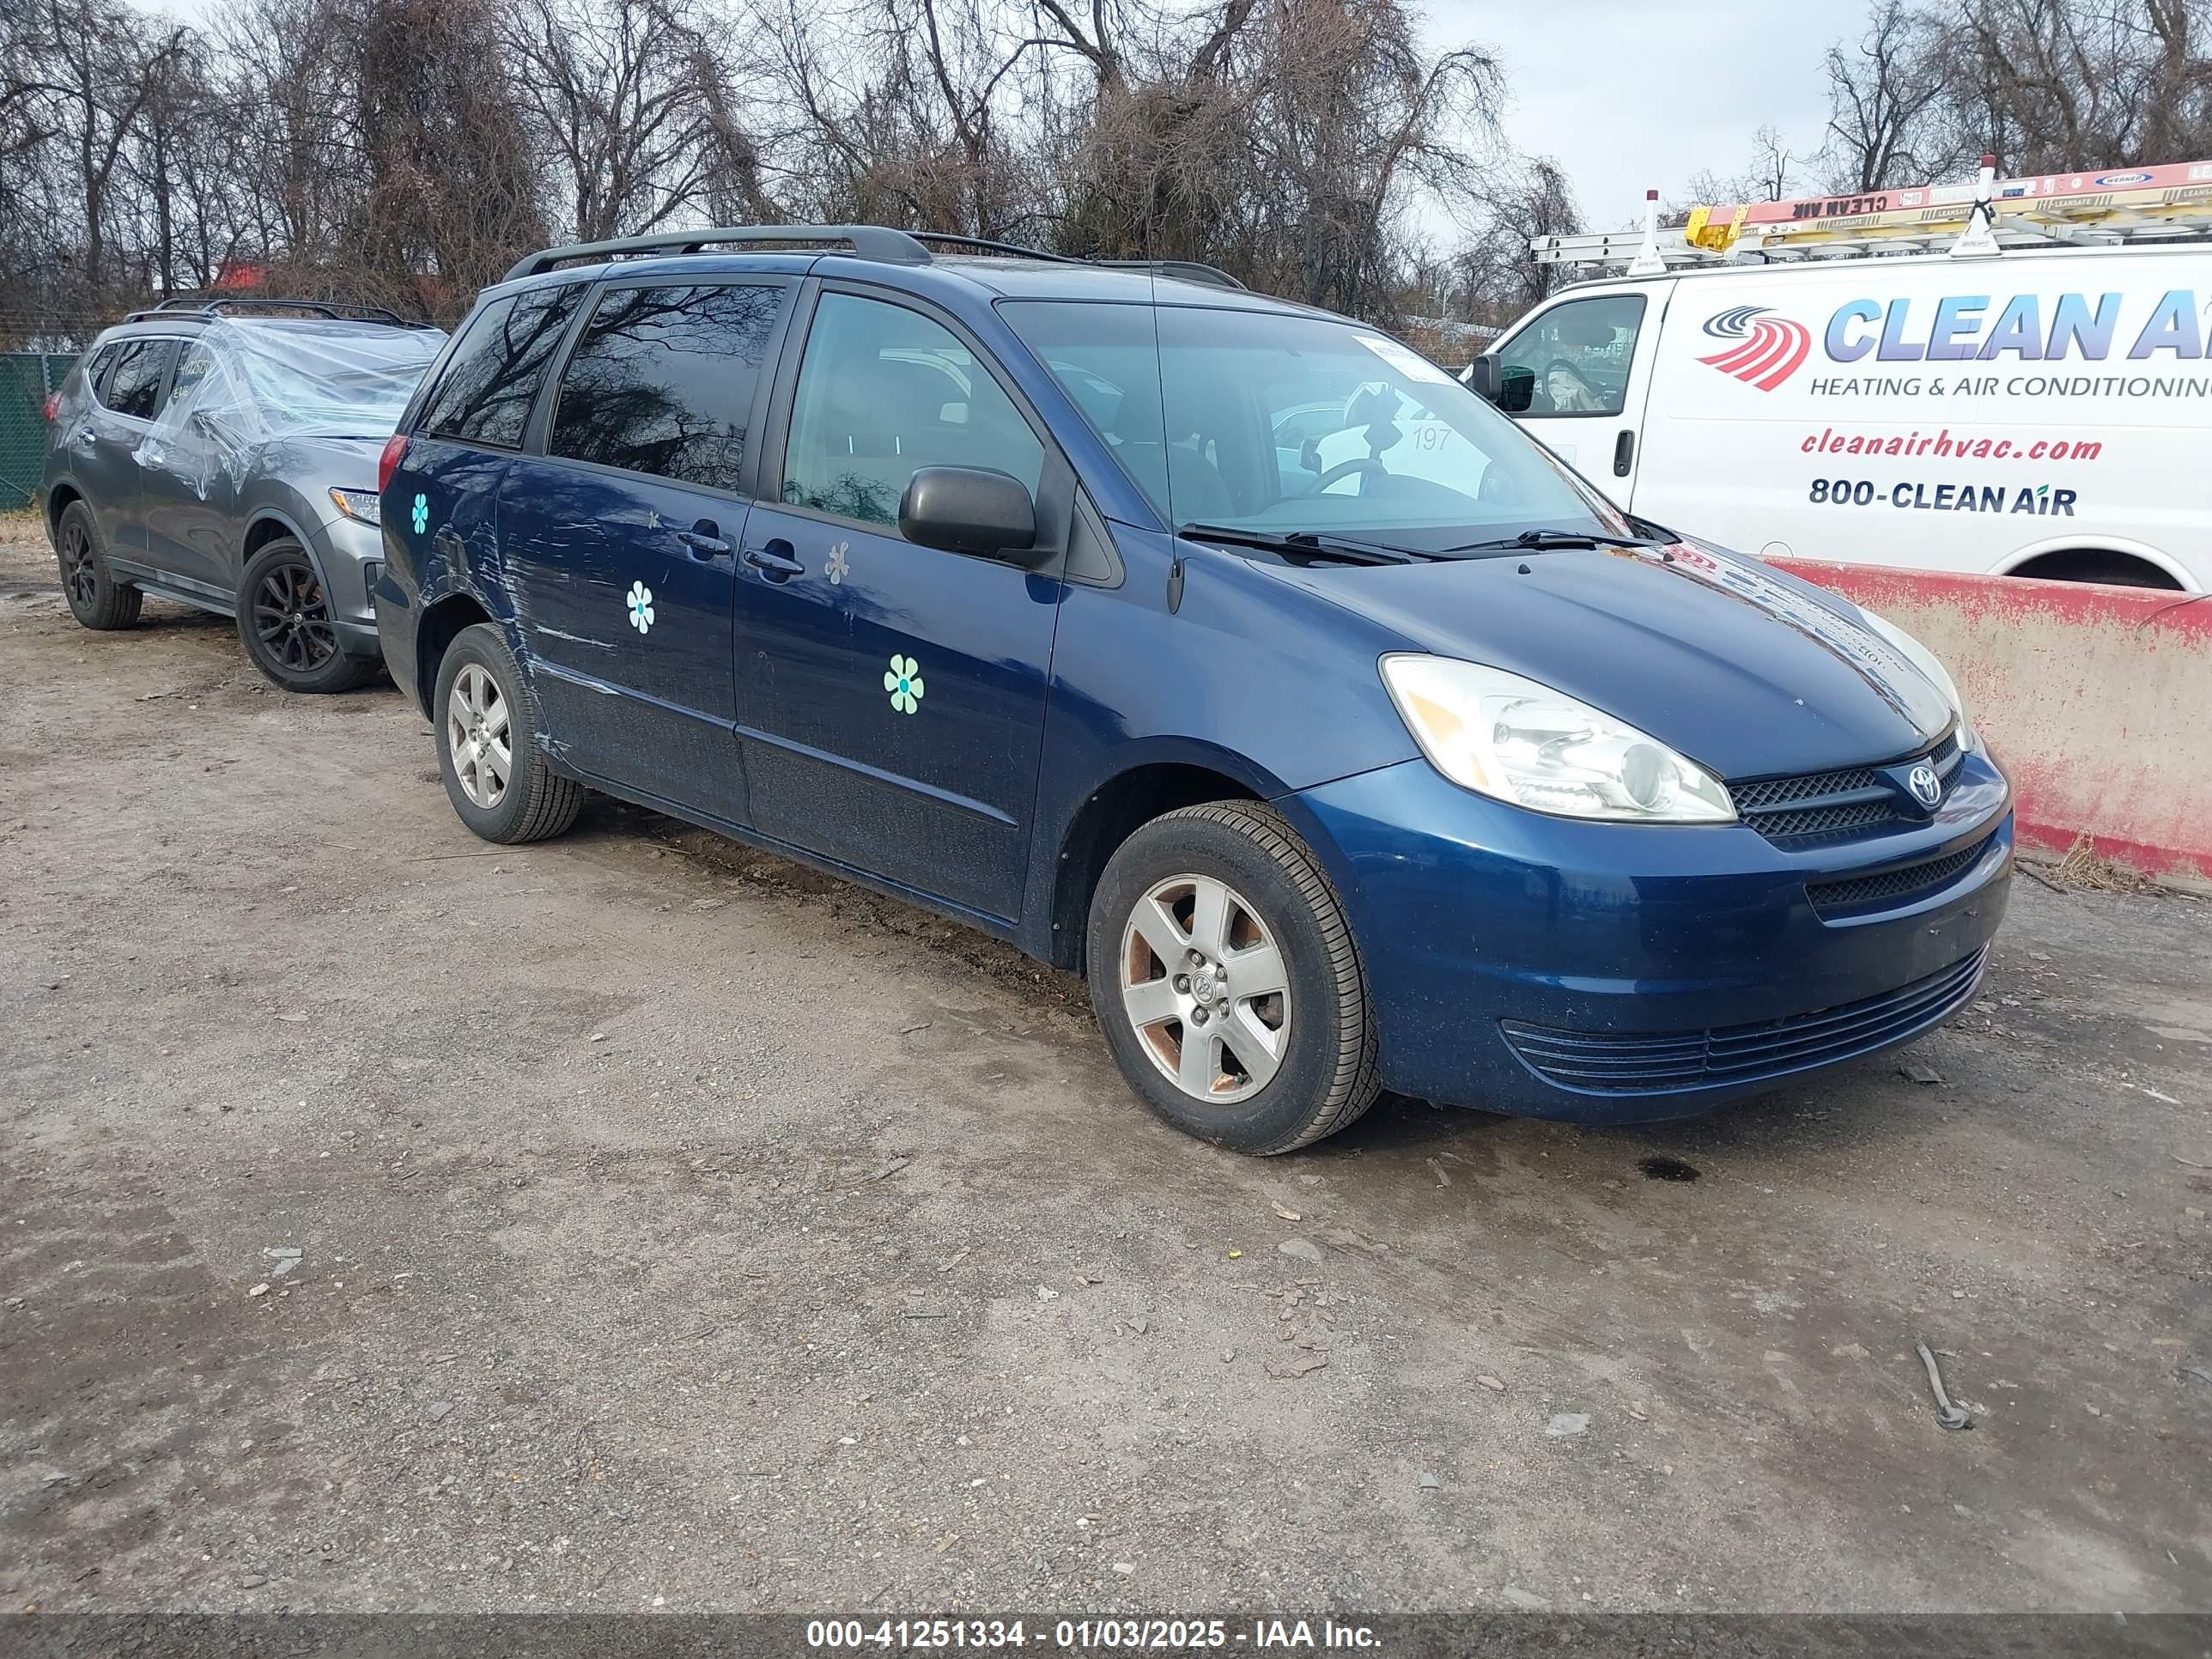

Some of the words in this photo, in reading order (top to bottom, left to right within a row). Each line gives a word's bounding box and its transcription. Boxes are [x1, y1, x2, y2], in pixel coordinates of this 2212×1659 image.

[1826, 196, 1887, 216] CLEAN
[2055, 198, 2091, 207] LEANSAFE
[1825, 292, 2124, 362] CLEAN
[1810, 377, 1921, 397] HEATING
[1929, 377, 1946, 397] &
[1954, 377, 2000, 397] AIR
[2007, 376, 2212, 398] CONDITIONIN
[1413, 427, 1452, 451] 197
[1801, 428, 2103, 461] cleanairhvac.com
[1808, 478, 2007, 514] 800-CLEAN
